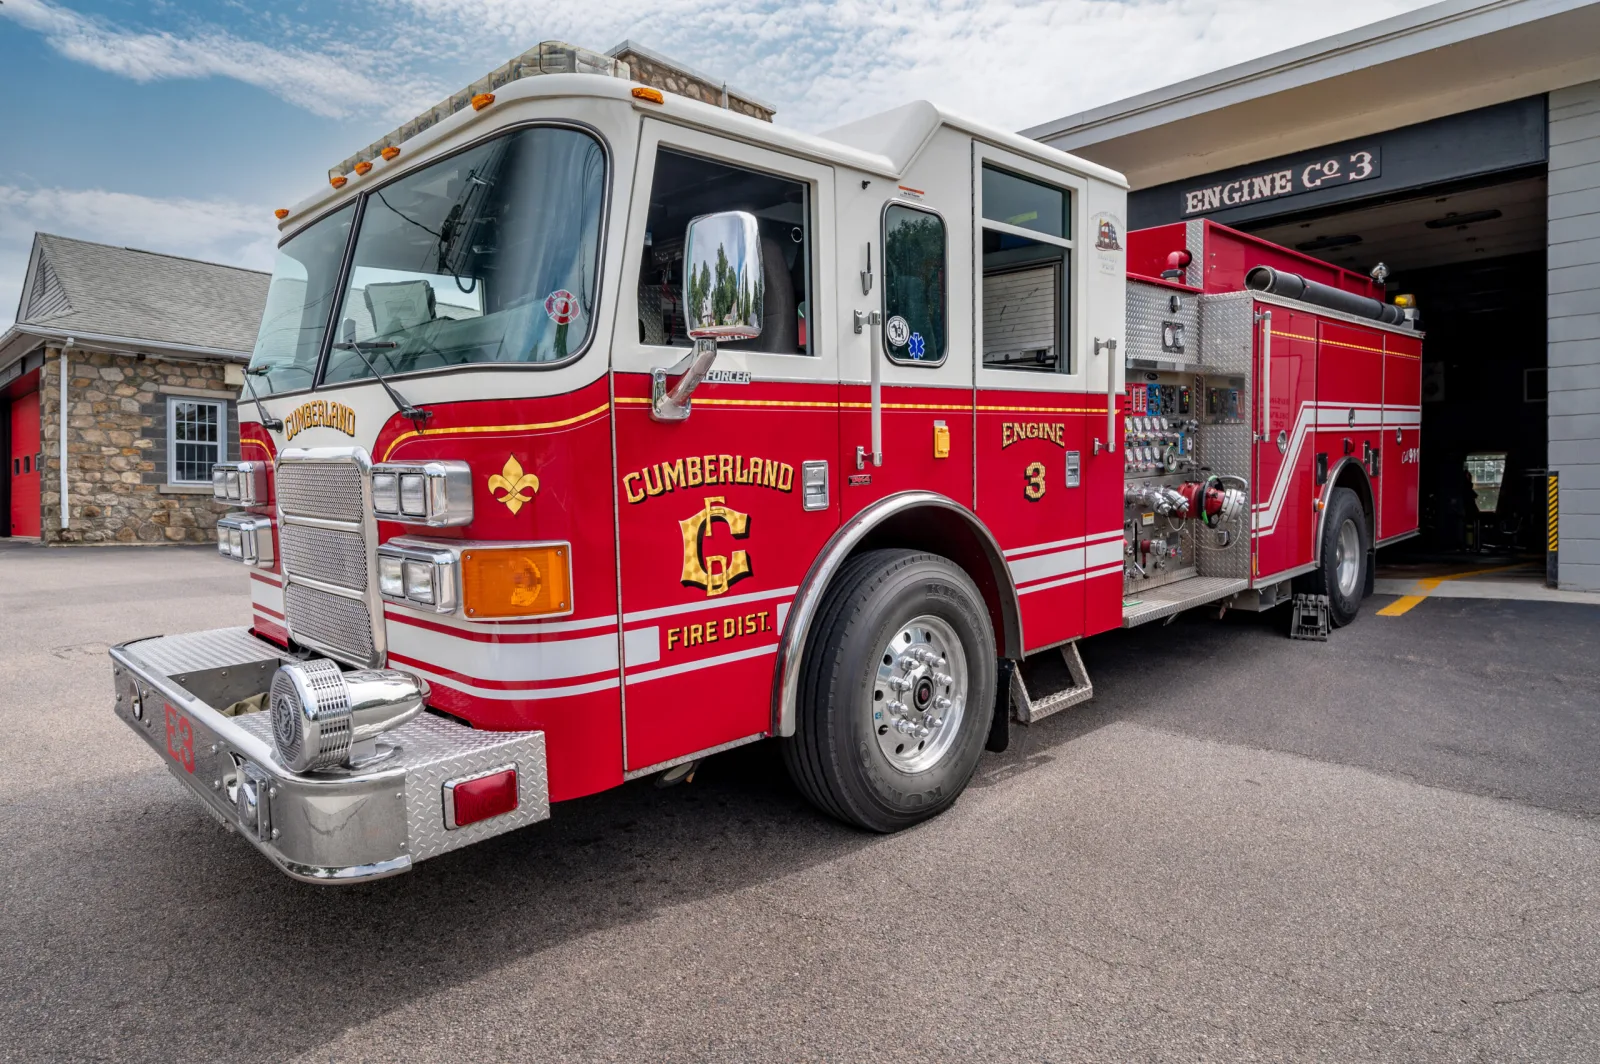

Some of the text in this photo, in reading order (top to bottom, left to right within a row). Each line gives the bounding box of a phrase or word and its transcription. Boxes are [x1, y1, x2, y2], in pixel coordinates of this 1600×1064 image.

[1185, 169, 1293, 214] ENGINE
[1349, 151, 1373, 181] 3
[703, 370, 752, 382] FORCER
[284, 399, 356, 442] CUMBERLAND
[1002, 421, 1066, 449] ENGINE
[622, 454, 794, 504] CUMBERLAND
[1023, 461, 1047, 503] 3
[667, 611, 772, 651] FIRE DIST.
[163, 702, 196, 774] E3
[859, 740, 944, 807] KUMHO
